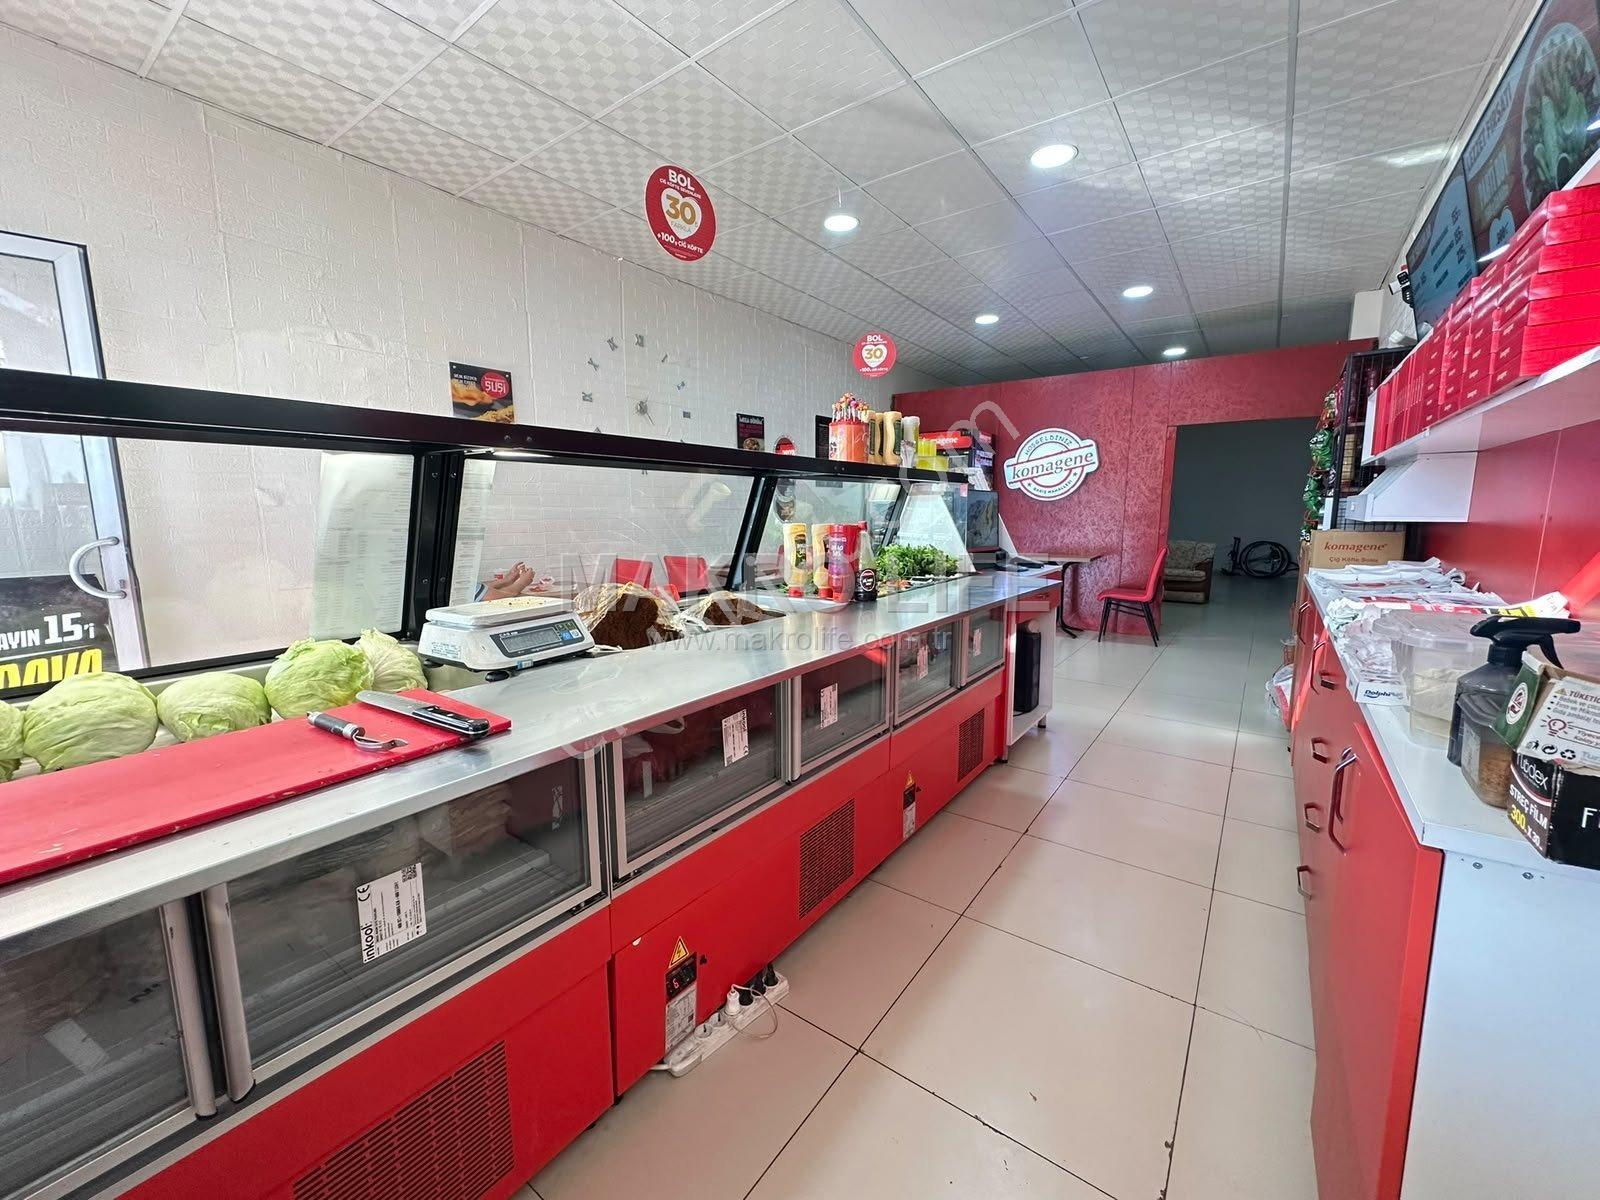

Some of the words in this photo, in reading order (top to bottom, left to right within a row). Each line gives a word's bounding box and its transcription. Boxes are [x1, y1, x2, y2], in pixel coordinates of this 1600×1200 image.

[668, 168, 695, 191] BOL
[665, 193, 697, 226] 30
[866, 334, 884, 342] BOL
[864, 347, 884, 360] 30
[1012, 451, 1094, 480] komagene
[1323, 541, 1386, 553] komagene
[1529, 803, 1549, 830] FİLM
[361, 922, 376, 962] inkool
